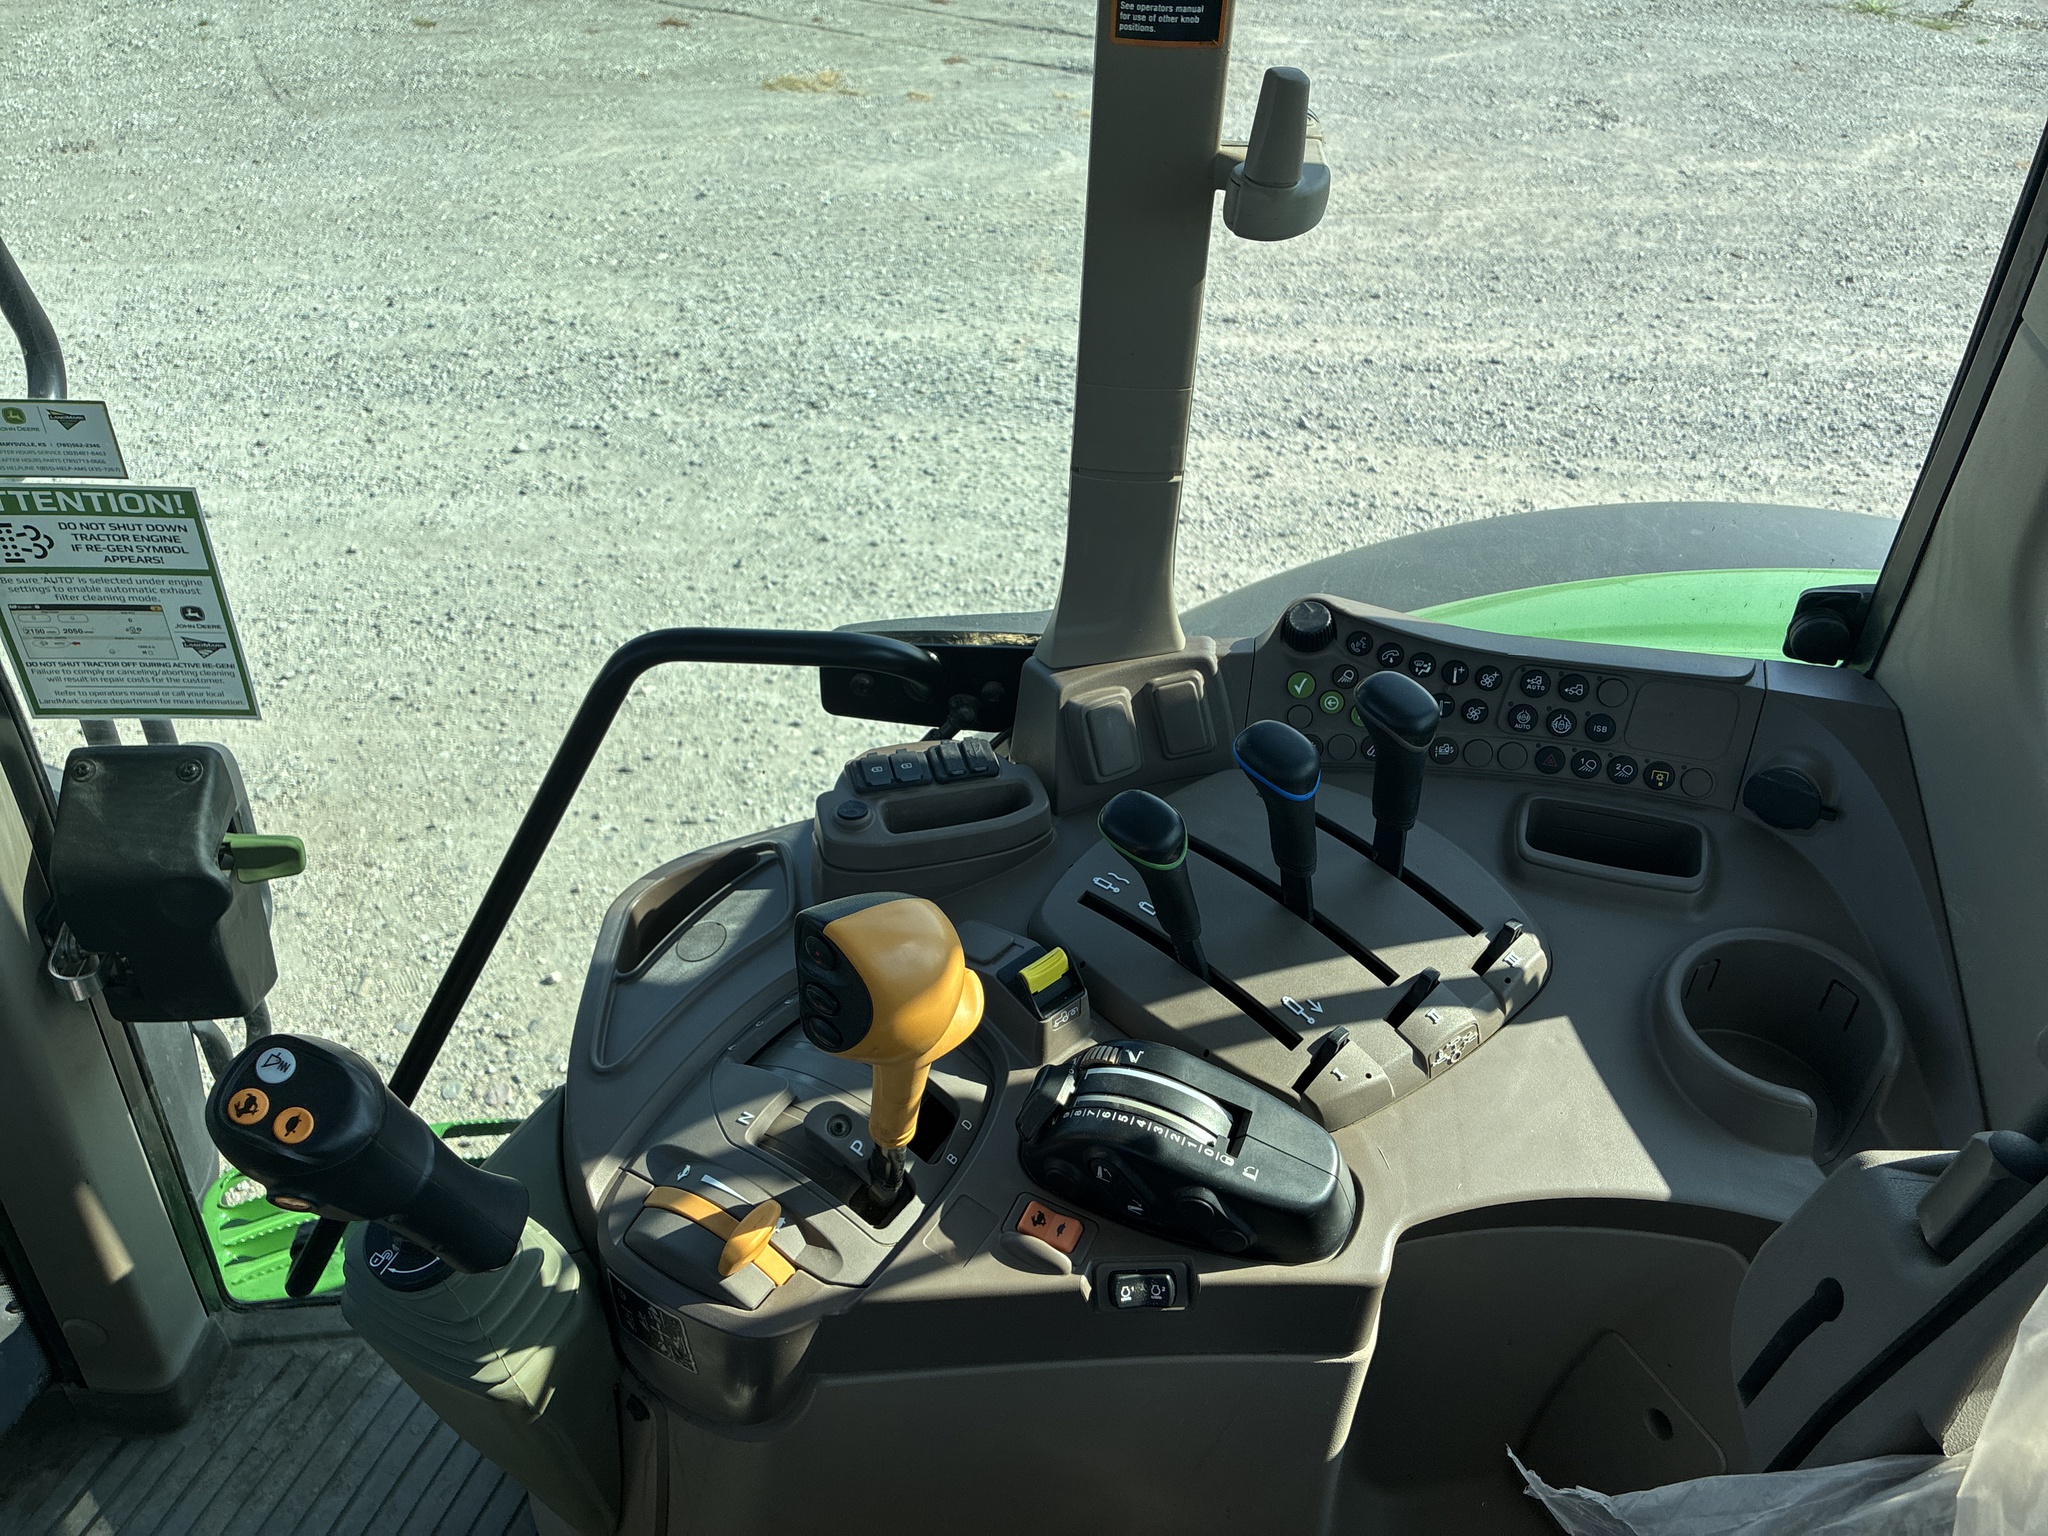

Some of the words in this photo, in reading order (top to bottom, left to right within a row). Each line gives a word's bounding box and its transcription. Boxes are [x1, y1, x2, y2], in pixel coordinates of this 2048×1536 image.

[1120, 2, 1134, 10] See
[1136, 2, 1173, 12] operators
[1176, 5, 1204, 13] manual
[1120, 12, 1130, 20] for
[1148, 14, 1156, 22] of
[1158, 15, 1178, 23] other
[1180, 15, 1200, 24] knob
[1119, 23, 1156, 32] positions.
[58, 522, 77, 530] DO
[80, 522, 106, 531] NOT
[109, 523, 143, 532] SHUT
[146, 524, 188, 533] DOWN
[72, 533, 130, 542] TRACTOR
[133, 534, 182, 543] ENGINE
[86, 545, 134, 553] RE-GEN
[136, 545, 189, 554] SYMBOL
[104, 556, 164, 564] APPEARS!
[168, 578, 203, 587] engine
[8, 586, 50, 594] settings
[83, 594, 126, 603] cleaning
[200, 670, 235, 678] cleaning
[737, 1111, 754, 1125] N
[961, 1119, 973, 1131] D
[1118, 1114, 1129, 1123] 5
[1136, 1119, 1146, 1128] 4
[1154, 1125, 1163, 1134] 3
[1170, 1134, 1180, 1142] 2
[1204, 1147, 1214, 1156] 0
[850, 1139, 865, 1157] P
[946, 1153, 958, 1165] B
